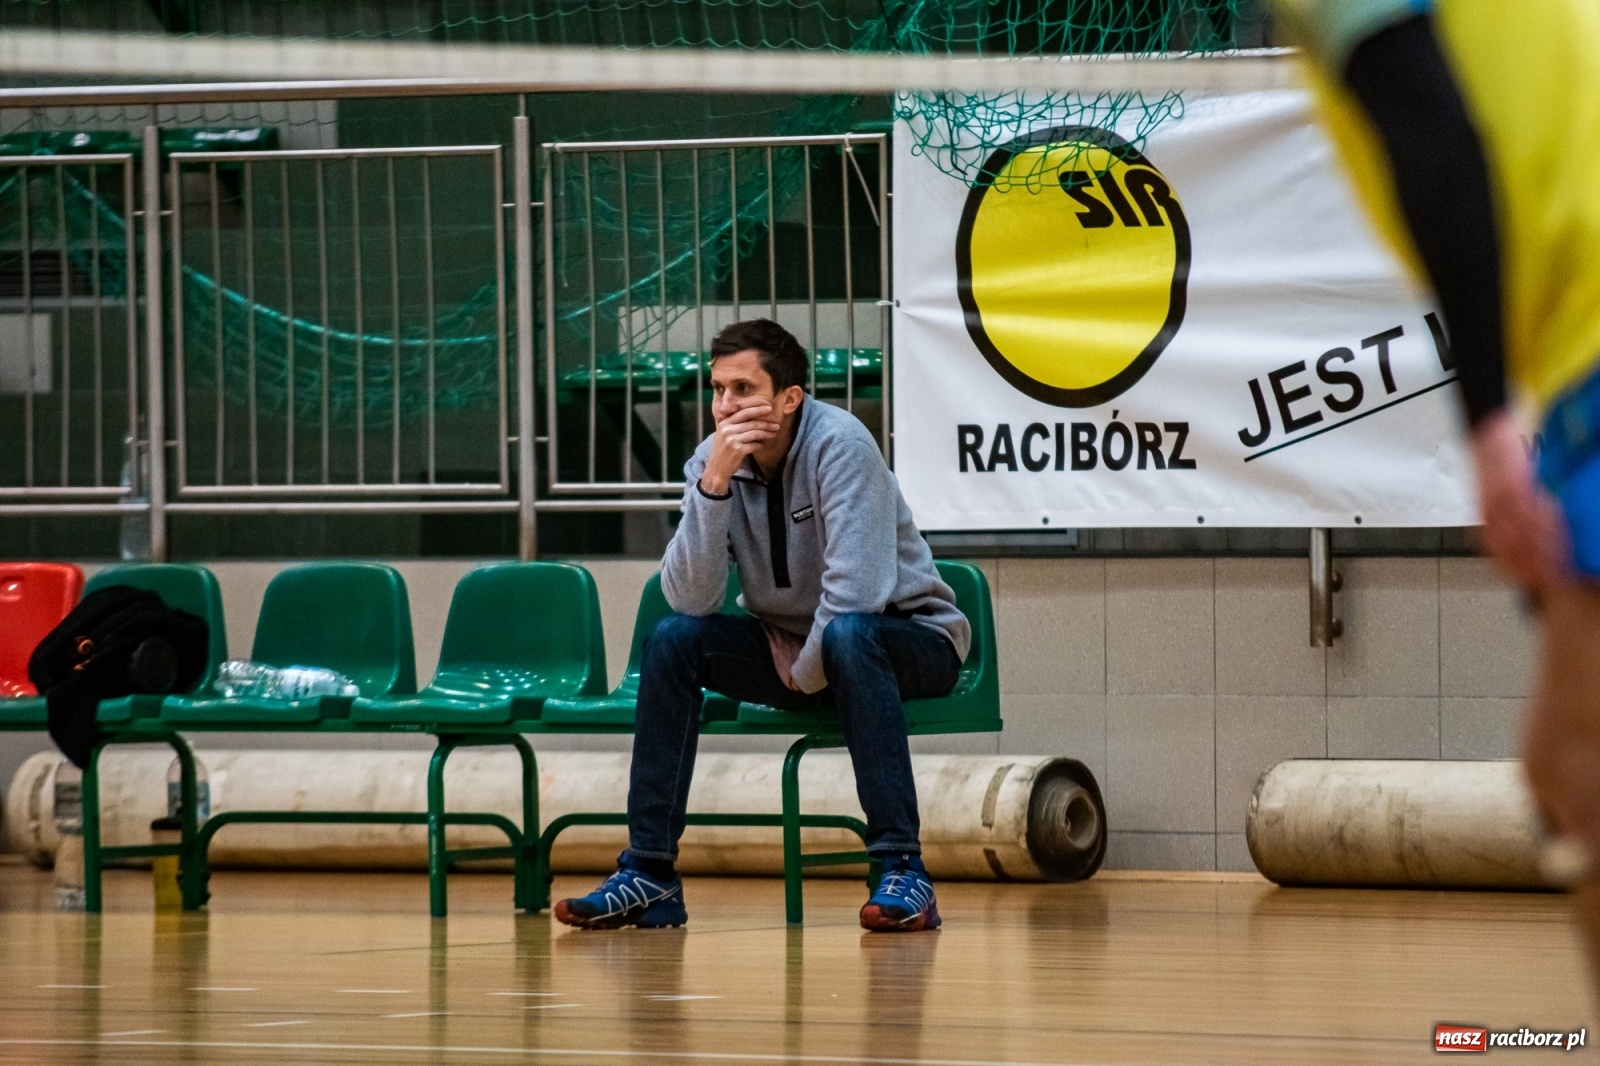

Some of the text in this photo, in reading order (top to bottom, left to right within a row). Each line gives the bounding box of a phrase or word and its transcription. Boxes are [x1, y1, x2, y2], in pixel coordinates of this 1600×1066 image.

[1058, 167, 1182, 229] SIR
[1236, 325, 1405, 449] JEST
[957, 409, 1197, 473] RACIBÓRZ
